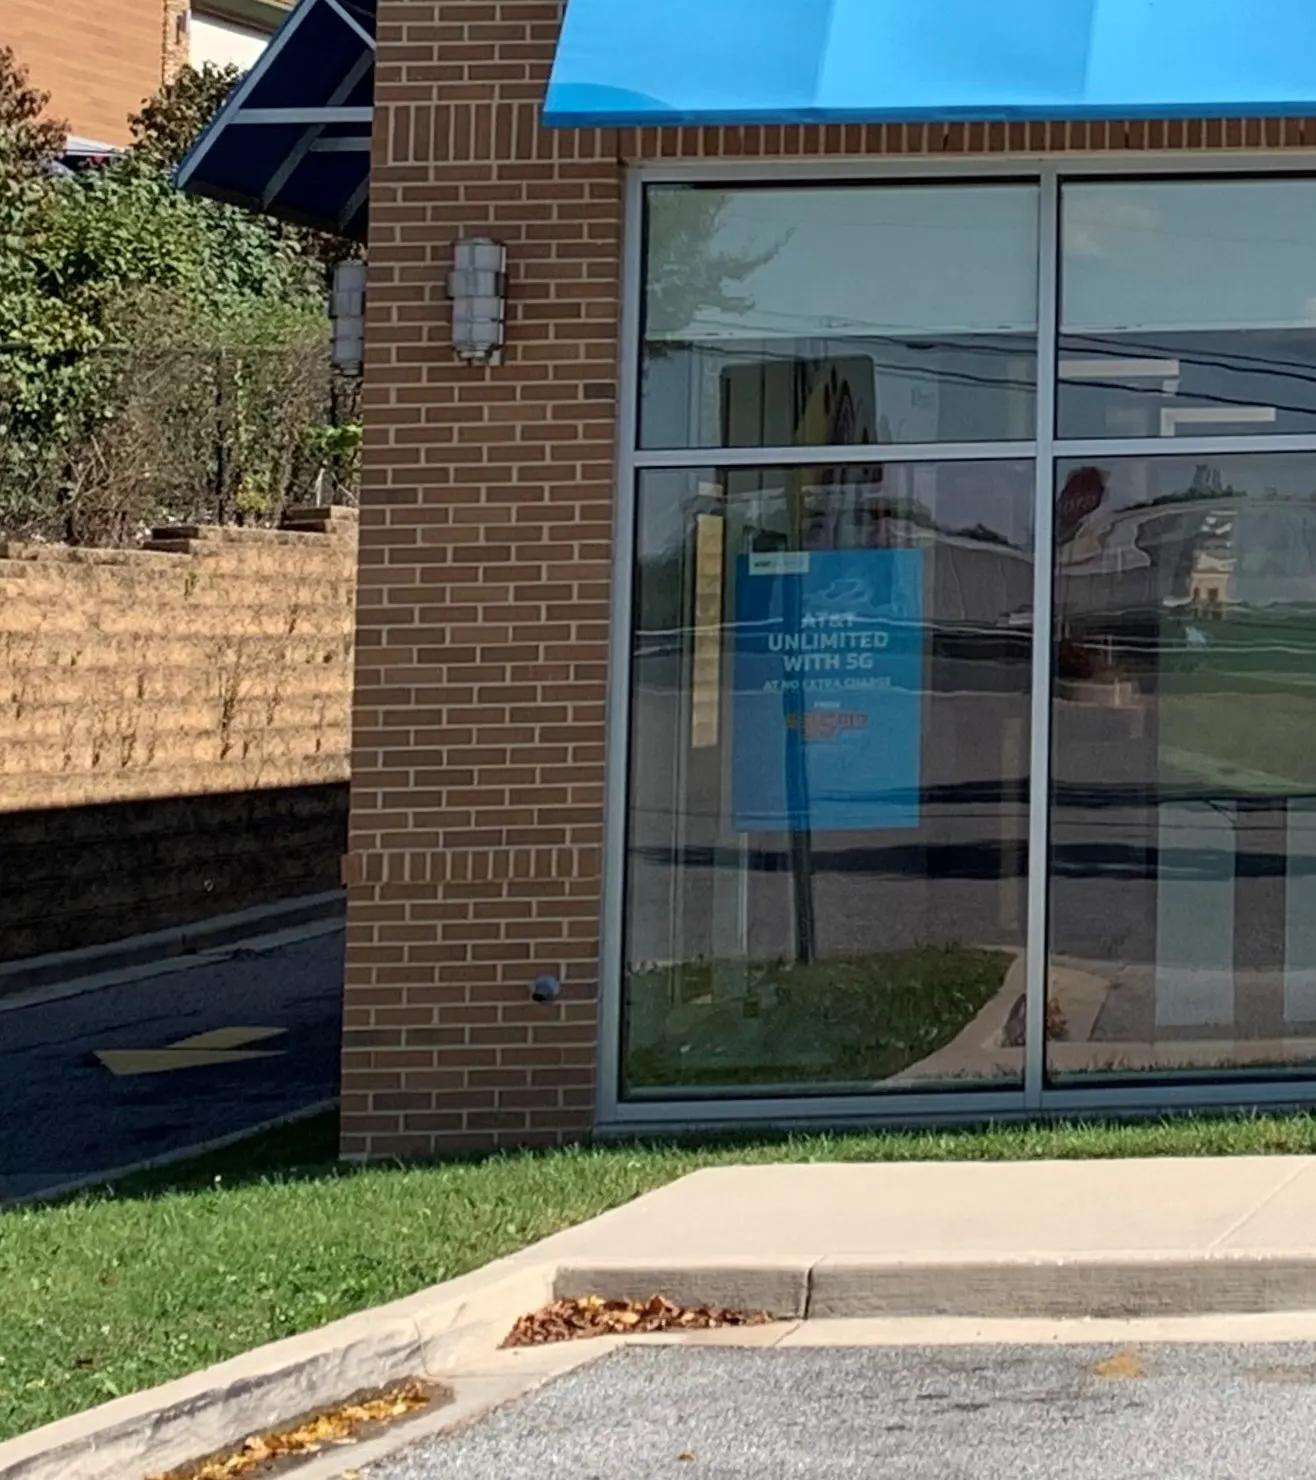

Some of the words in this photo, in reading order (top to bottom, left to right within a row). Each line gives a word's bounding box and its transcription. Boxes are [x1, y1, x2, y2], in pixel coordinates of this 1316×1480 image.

[800, 611, 855, 629] AT&T
[768, 631, 889, 651] UNLIMITED
[783, 653, 840, 671] WITH
[845, 652, 874, 670] 5G
